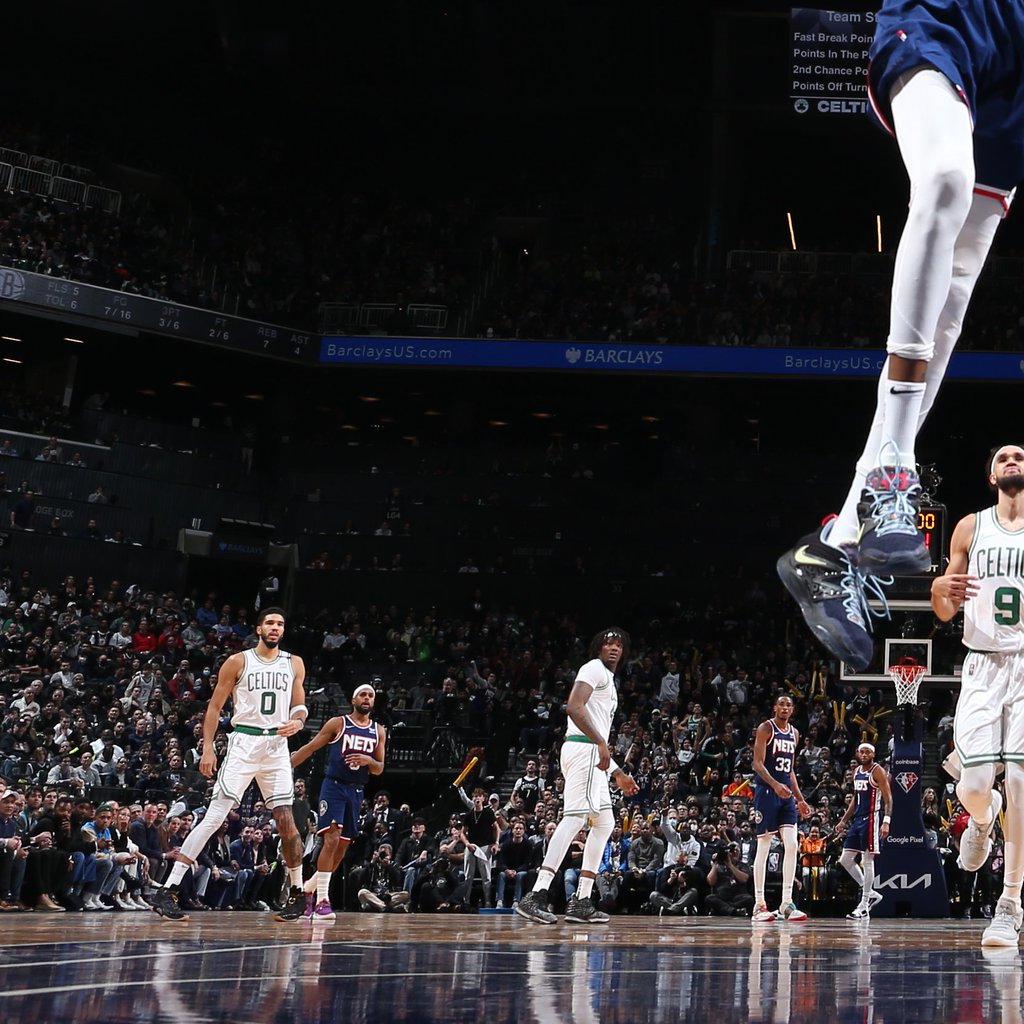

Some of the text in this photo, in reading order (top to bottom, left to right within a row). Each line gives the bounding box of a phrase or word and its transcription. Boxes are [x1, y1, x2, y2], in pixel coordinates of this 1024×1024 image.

[826, 10, 861, 23] Team
[793, 32, 875, 44] Fast Break Poin
[793, 49, 825, 59] Points
[828, 50, 838, 59] In
[840, 50, 859, 59] The
[792, 65, 812, 74] 2nd
[814, 66, 853, 75] Chance
[792, 81, 825, 91] Points
[827, 82, 842, 91] Off
[73, 287, 80, 296] 5
[70, 300, 78, 310] 6
[113, 296, 128, 307] FG
[257, 327, 278, 338] REB
[263, 340, 270, 349] 7
[327, 343, 453, 360] BarclaysUS.com
[584, 348, 664, 365] BARCLAYS
[994, 586, 1021, 626] 9
[247, 671, 289, 692] CELTICS
[260, 691, 276, 715] 0
[341, 733, 377, 754] NETS
[772, 738, 796, 755] NETS
[775, 757, 792, 773] 33
[886, 836, 909, 845] Google
